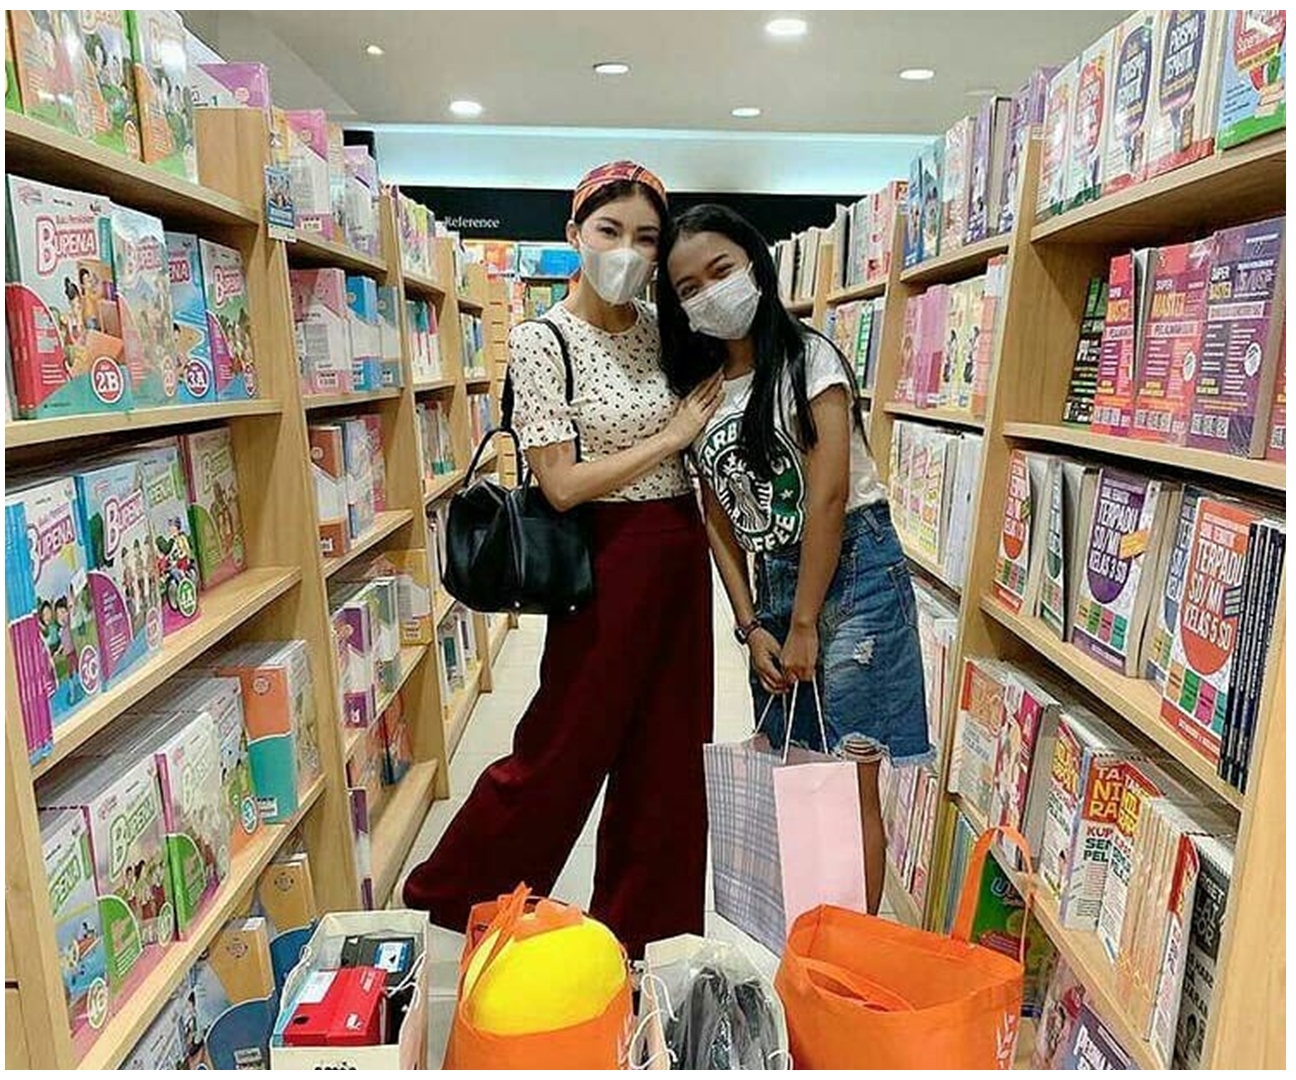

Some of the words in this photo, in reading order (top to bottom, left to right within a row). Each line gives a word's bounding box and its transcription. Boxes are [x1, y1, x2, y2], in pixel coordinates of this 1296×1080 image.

[444, 215, 501, 229] Reference
[735, 514, 796, 552] OFFEE
[1097, 499, 1140, 535] TERPADU
[1196, 539, 1247, 587] TERPADU
